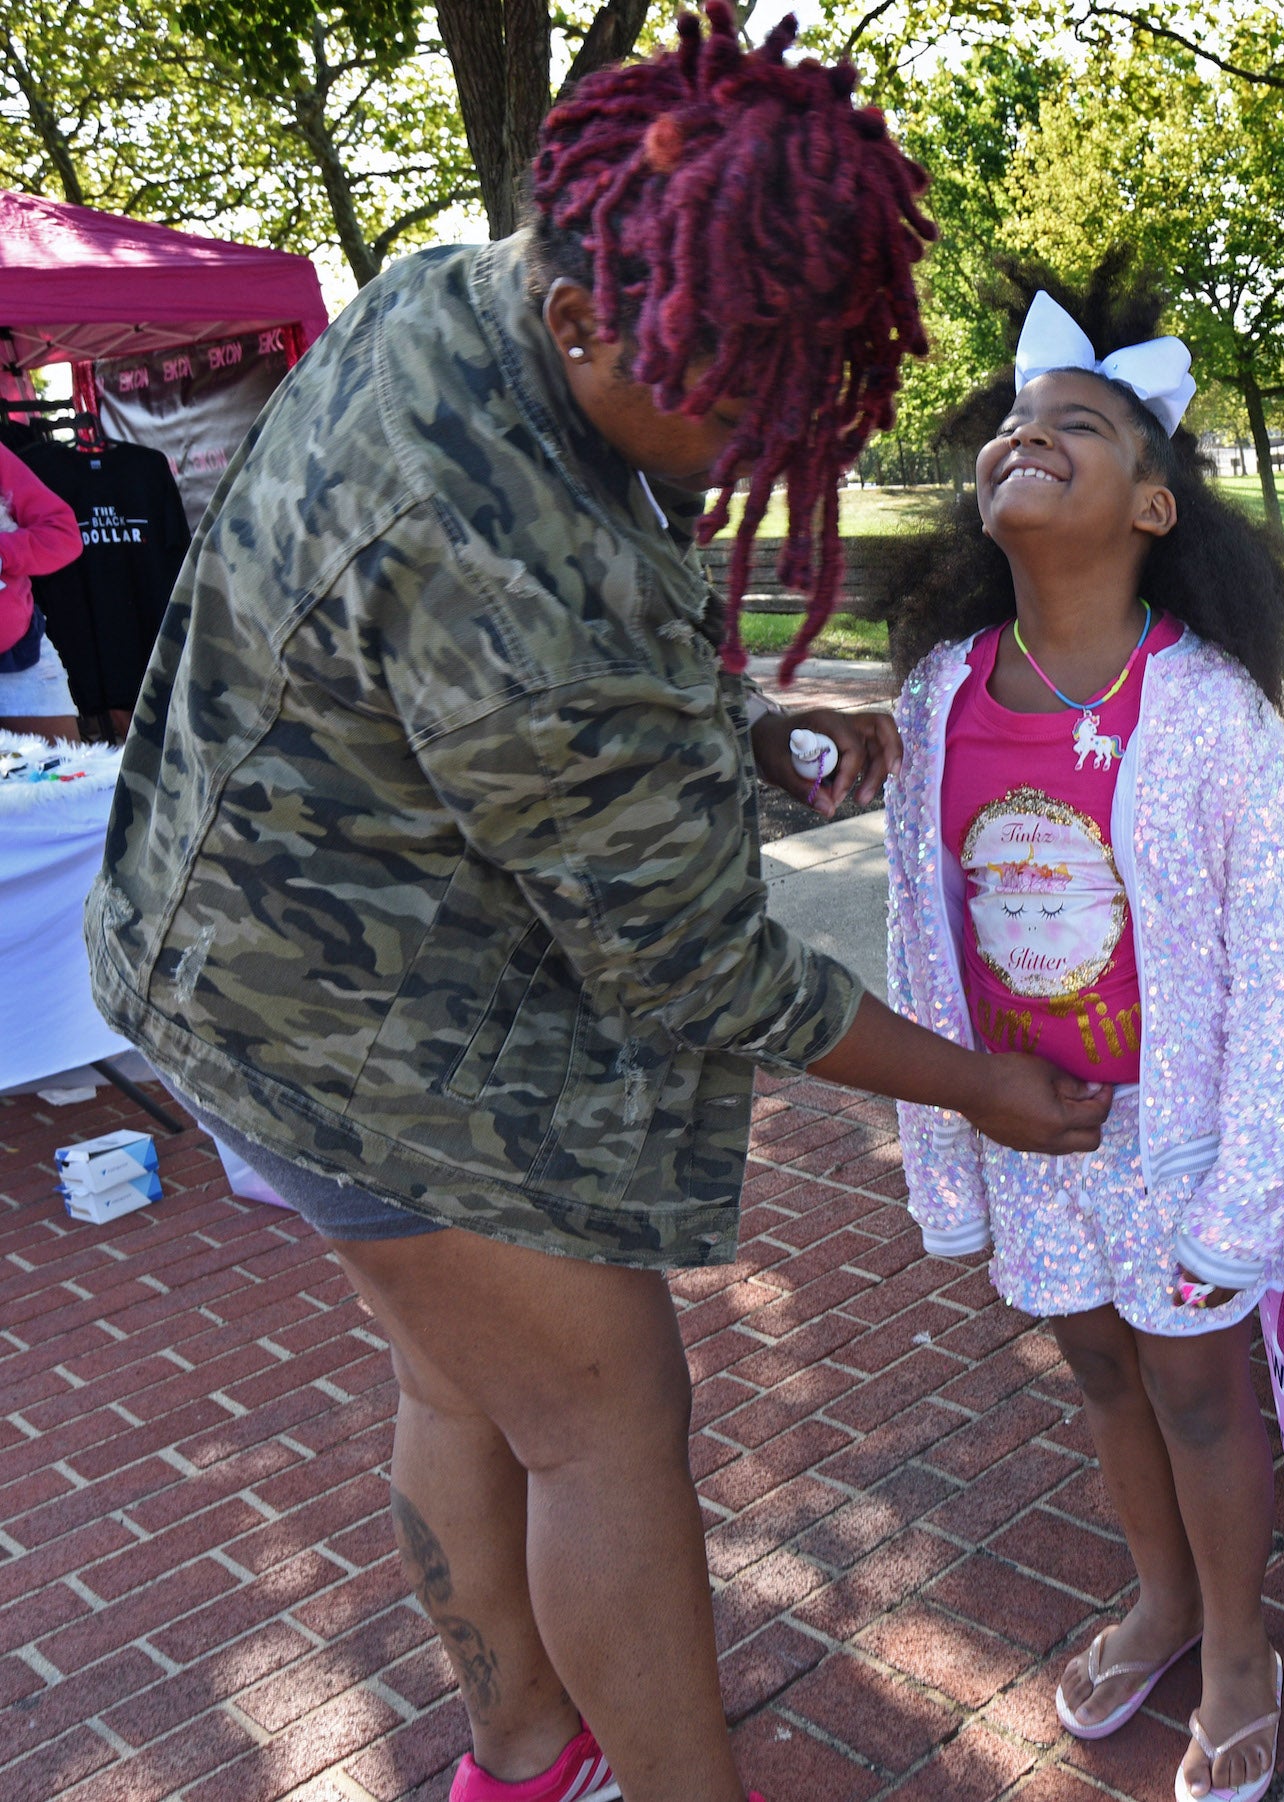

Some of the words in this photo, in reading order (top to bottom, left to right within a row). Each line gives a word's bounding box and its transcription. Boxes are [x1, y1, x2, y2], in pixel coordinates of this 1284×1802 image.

[93, 506, 116, 516] THE
[91, 516, 126, 528] BLACK
[1001, 822, 1054, 843] Tinkz
[1008, 945, 1067, 971] Glitter
